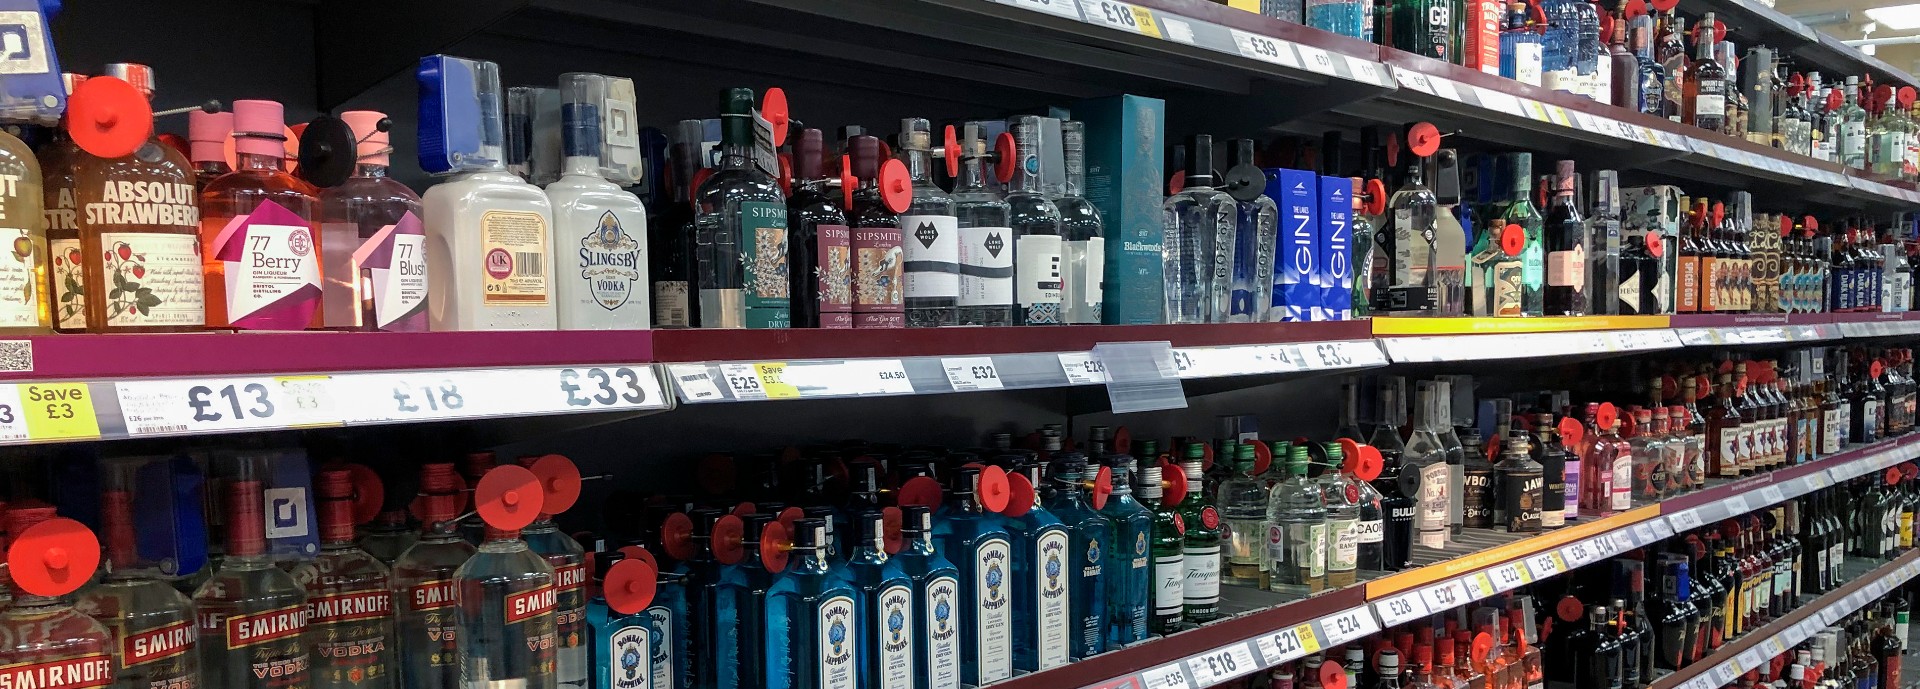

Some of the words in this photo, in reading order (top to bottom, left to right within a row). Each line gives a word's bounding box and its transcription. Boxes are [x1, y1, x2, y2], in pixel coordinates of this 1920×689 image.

[1101, 2, 1136, 27] £18
[1250, 36, 1280, 58] £39
[103, 180, 195, 205] ABSOLUT
[250, 235, 271, 251] 77
[398, 243, 413, 259] 77
[1123, 241, 1161, 252] Blackwoods
[1293, 214, 1312, 275] GIN
[1331, 220, 1346, 279] GIN
[252, 251, 302, 273] Berry
[492, 255, 507, 265] UK
[580, 247, 641, 270] SLINGSBY
[400, 260, 426, 276] Blush
[1684, 262, 1694, 287] SPICED
[597, 279, 625, 291] VODKA
[762, 365, 783, 374] Save
[879, 371, 905, 380] £24.50
[972, 365, 997, 379] £32
[559, 367, 646, 407] £33
[730, 376, 759, 390] £25
[28, 385, 83, 401] Save
[393, 379, 464, 413] £18
[46, 403, 75, 419] £3
[188, 383, 275, 422] £13
[1042, 541, 1064, 556] BOMBAY
[982, 549, 1005, 566] BOMBAY
[1501, 566, 1520, 584] £22
[931, 585, 952, 601] BOMBAY
[1042, 583, 1065, 599] SAPPHIRE
[307, 595, 389, 619] SMIRNOFF
[885, 594, 907, 610] BOMBAY
[982, 593, 1007, 610] SAPPHIRE
[1391, 598, 1412, 617] £28
[825, 605, 849, 622] BOMBAY
[931, 625, 955, 641] SAPPHIRE
[1337, 614, 1361, 636] £24
[319, 641, 386, 658] VODKA
[617, 634, 643, 649] BOMBAY
[884, 636, 908, 653] SAPPHIRE
[1274, 629, 1302, 655] £21
[825, 648, 851, 666] SAPPHIRE
[1207, 651, 1237, 677] £18
[0, 659, 111, 689] SMIRNOFF
[617, 673, 645, 688] SAPPHIRE
[1165, 671, 1184, 688] £35
